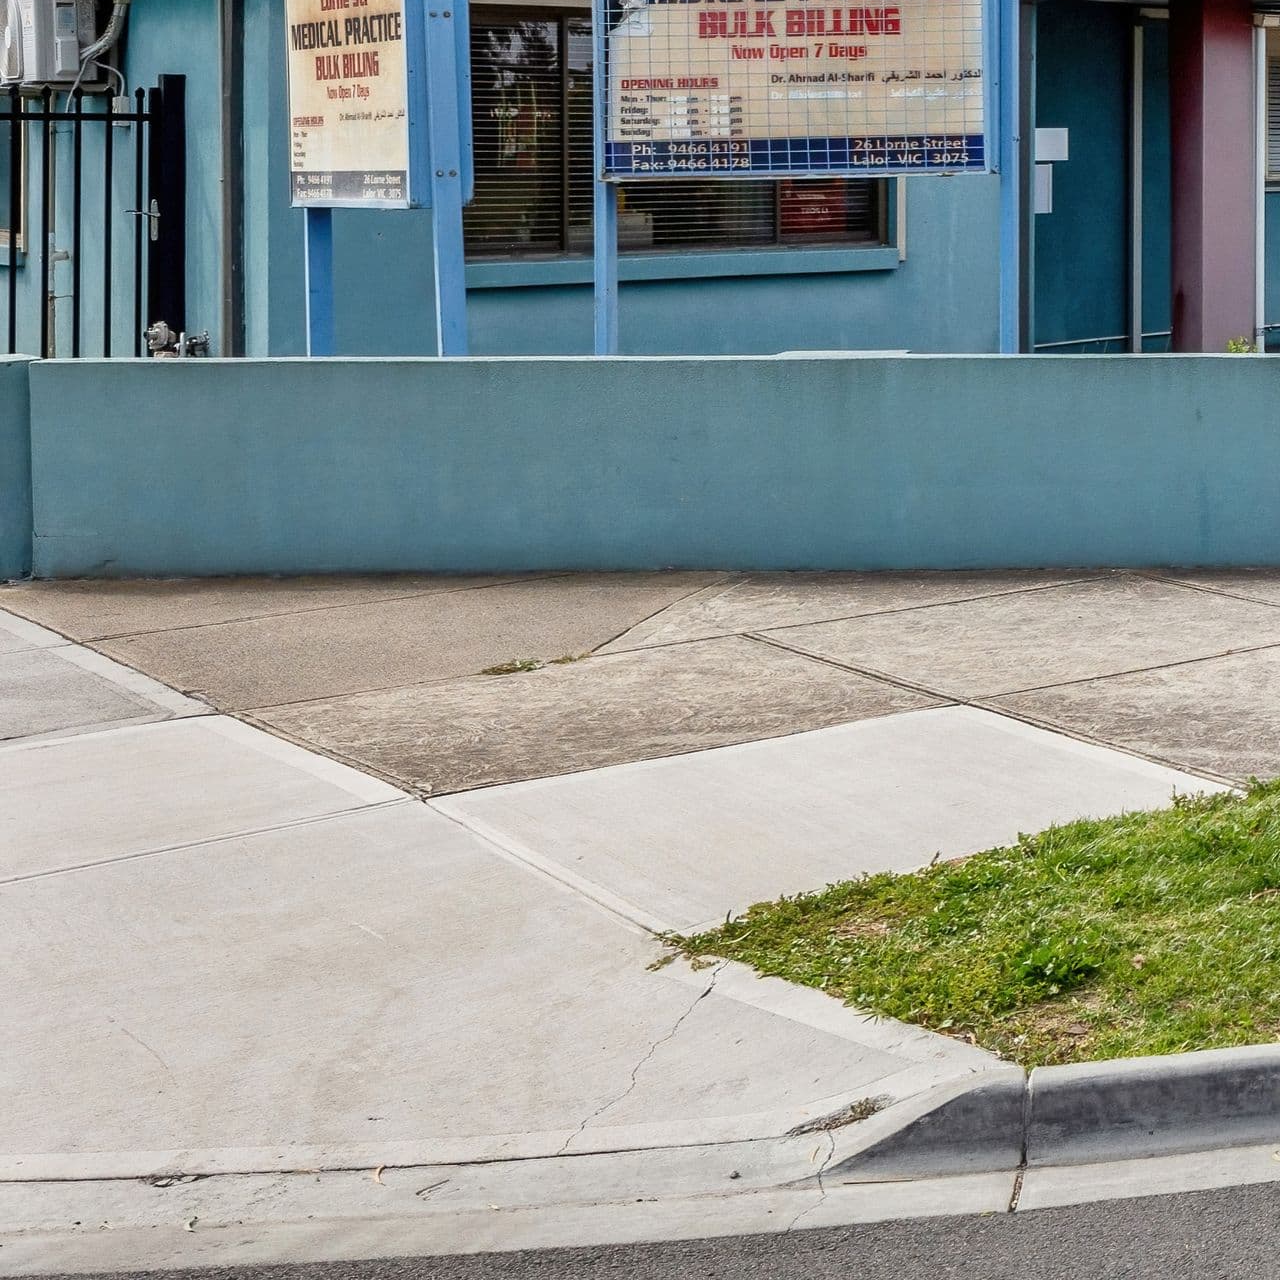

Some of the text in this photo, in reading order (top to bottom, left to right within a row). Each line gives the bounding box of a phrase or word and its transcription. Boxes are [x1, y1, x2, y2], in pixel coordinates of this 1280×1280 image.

[699, 8, 901, 38] BULK BILLING
[291, 12, 402, 51] MEDICAL PRACTICE
[732, 43, 867, 61] Now Open 7 Days
[316, 51, 379, 80] BULK BILLING
[621, 77, 719, 90] OPENING HOURS
[771, 71, 875, 83] Dr. Ahmad Al-Sharifi
[353, 84, 356, 98] 7
[632, 143, 748, 155] Ph: 9466 4191
[854, 137, 968, 150] 26 Lorne Street
[632, 157, 750, 170] Fax: 9466 4178
[853, 153, 969, 165] Lalor VIC 3075
